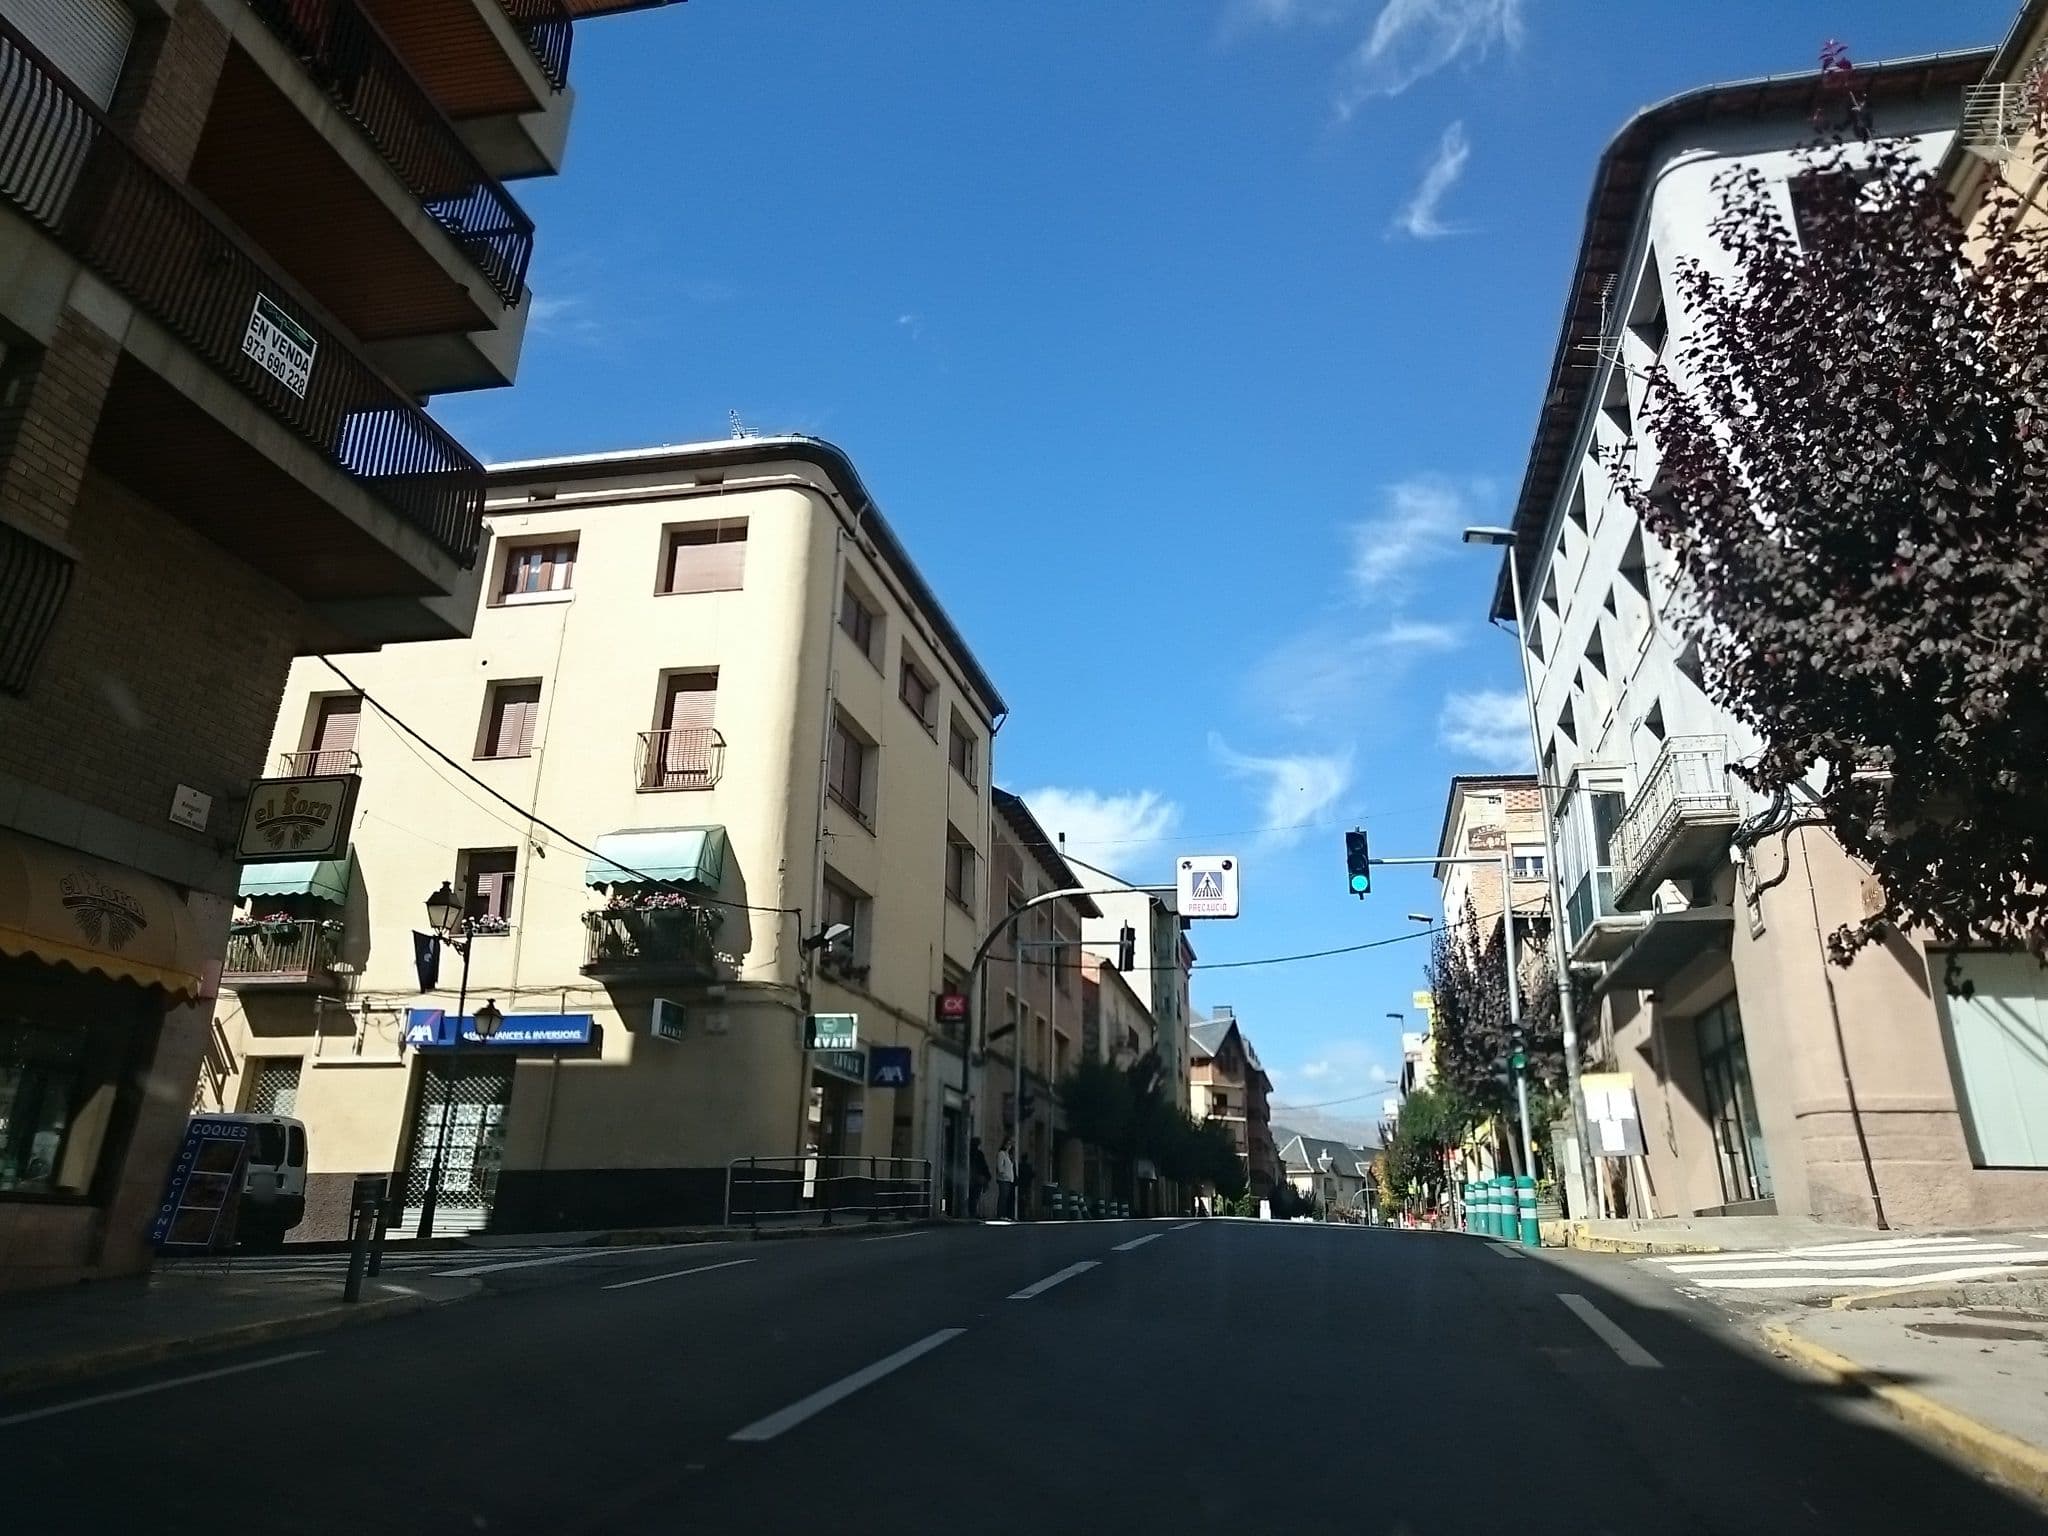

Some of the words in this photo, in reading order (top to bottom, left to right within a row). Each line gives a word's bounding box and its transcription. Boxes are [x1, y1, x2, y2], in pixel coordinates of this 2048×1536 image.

[250, 314, 269, 341] EN
[271, 329, 309, 376] VENDA
[245, 335, 266, 362] 973
[266, 353, 286, 379] 690
[286, 369, 305, 395] 228
[254, 799, 274, 822] el
[282, 786, 333, 820] forn
[944, 999, 964, 1011] CX
[406, 1024, 433, 1042] AXA
[525, 1031, 531, 1040] &
[533, 1030, 581, 1040] INVERSIONS
[874, 1066, 904, 1081] AXA
[191, 1123, 248, 1137] COQUES
[153, 1139, 196, 1240] PORCIONS
